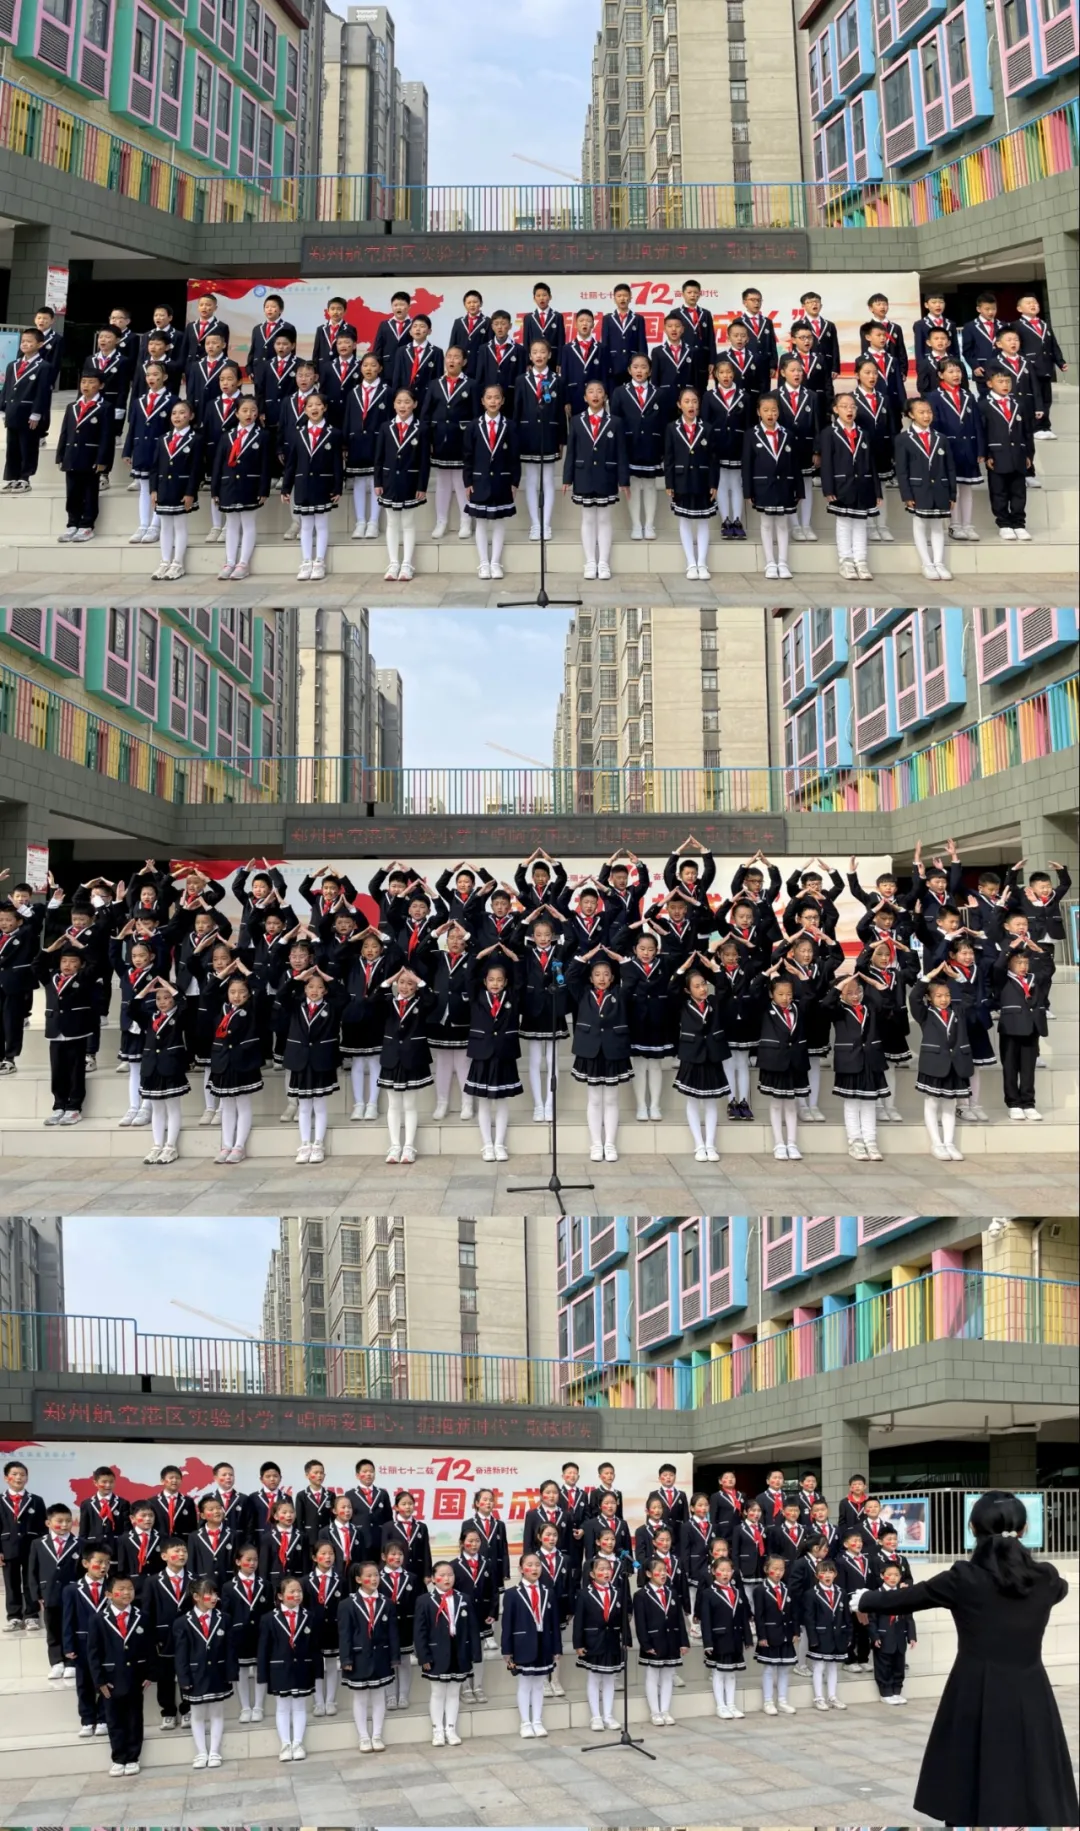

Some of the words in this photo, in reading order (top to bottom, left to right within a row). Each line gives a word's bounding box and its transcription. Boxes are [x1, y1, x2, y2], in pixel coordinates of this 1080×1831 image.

[630, 281, 674, 305] 72
[379, 1466, 434, 1475] 壮丽七十二载
[431, 1457, 475, 1482] 72
[475, 1466, 519, 1475] 奋进新时代
